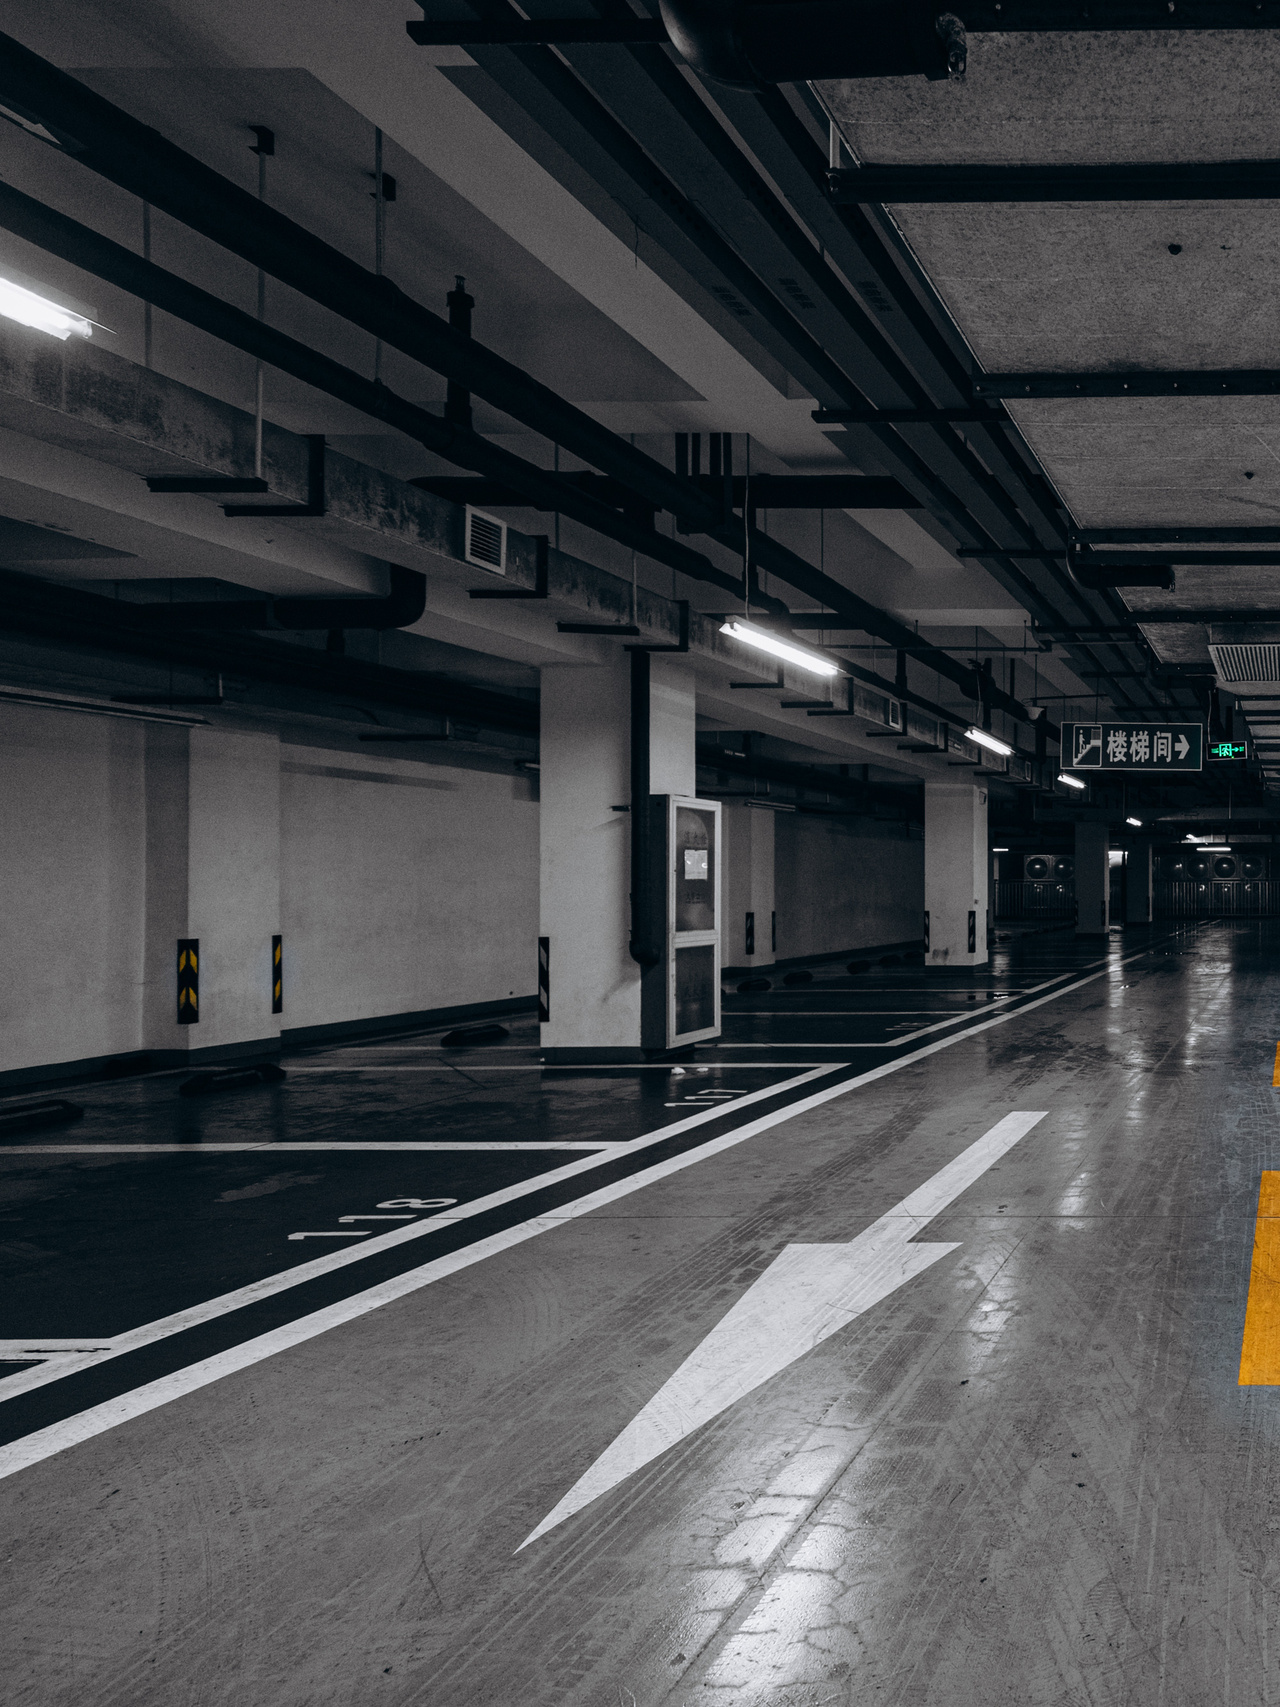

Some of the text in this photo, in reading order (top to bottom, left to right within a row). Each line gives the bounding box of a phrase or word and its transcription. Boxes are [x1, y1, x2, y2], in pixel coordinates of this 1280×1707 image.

[1107, 729, 1173, 763] 楼梯间
[287, 1197, 459, 1241] 118
